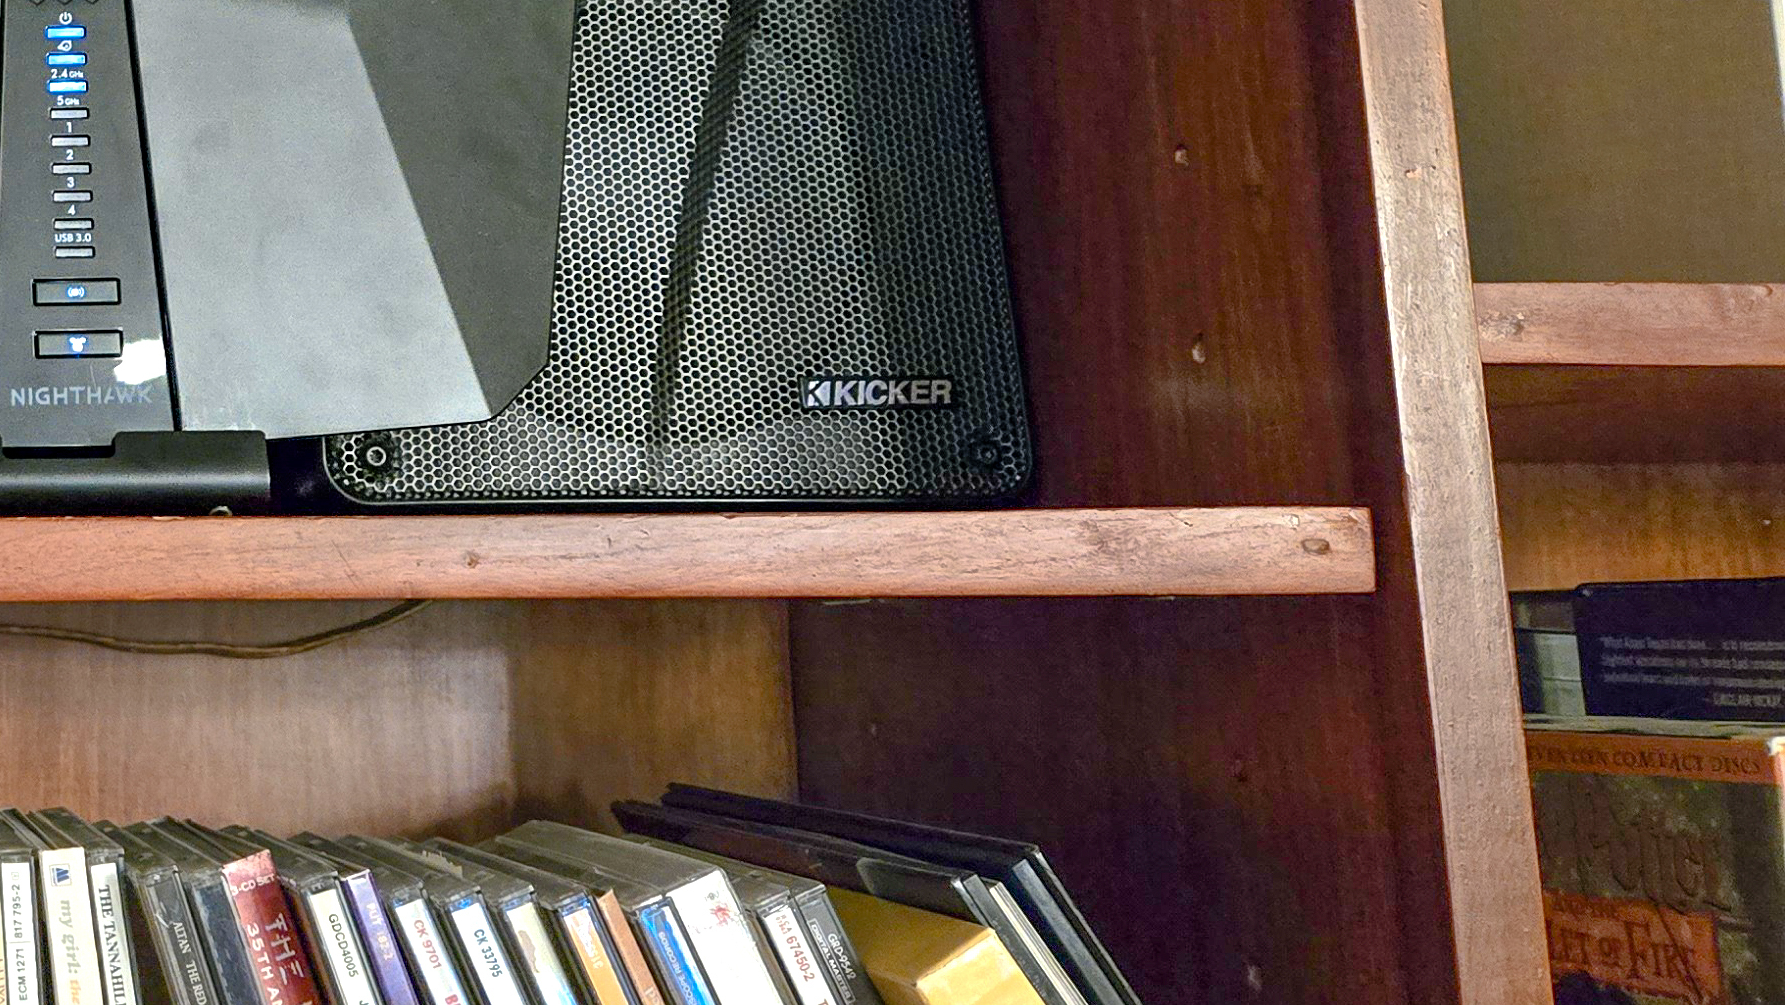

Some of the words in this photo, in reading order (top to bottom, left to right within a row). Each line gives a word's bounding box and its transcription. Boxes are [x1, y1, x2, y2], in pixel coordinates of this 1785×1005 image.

[66, 122, 72, 133] 1
[65, 150, 74, 160] 2
[66, 177, 75, 188] 3
[67, 205, 76, 215] 4
[54, 233, 74, 243] USB
[75, 233, 92, 243] 3.0
[10, 385, 153, 407] NIGHTHAWK
[833, 379, 953, 407] KICKER
[1613, 752, 1704, 772] COMPACT
[1710, 755, 1761, 775] DISCS
[11, 884, 21, 915] 795-2
[98, 884, 112, 918] THE
[59, 899, 74, 929] my
[366, 902, 383, 926] PUT
[13, 920, 22, 939] 817
[474, 928, 490, 950] CK
[810, 924, 831, 959] DIGITAL
[61, 933, 81, 975] girl:
[171, 920, 192, 954] ALTAN
[185, 960, 200, 985] THE
[247, 922, 272, 981] 35TH
[265, 912, 305, 986] THE
[328, 913, 359, 978] GDCD4005
[414, 919, 429, 938] CK
[422, 938, 442, 970] 9701
[15, 948, 25, 972] 1271
[481, 947, 504, 978] 33795
[786, 935, 816, 982] 67450-2
[17, 975, 27, 1001] ECM
[69, 978, 83, 1005] the
